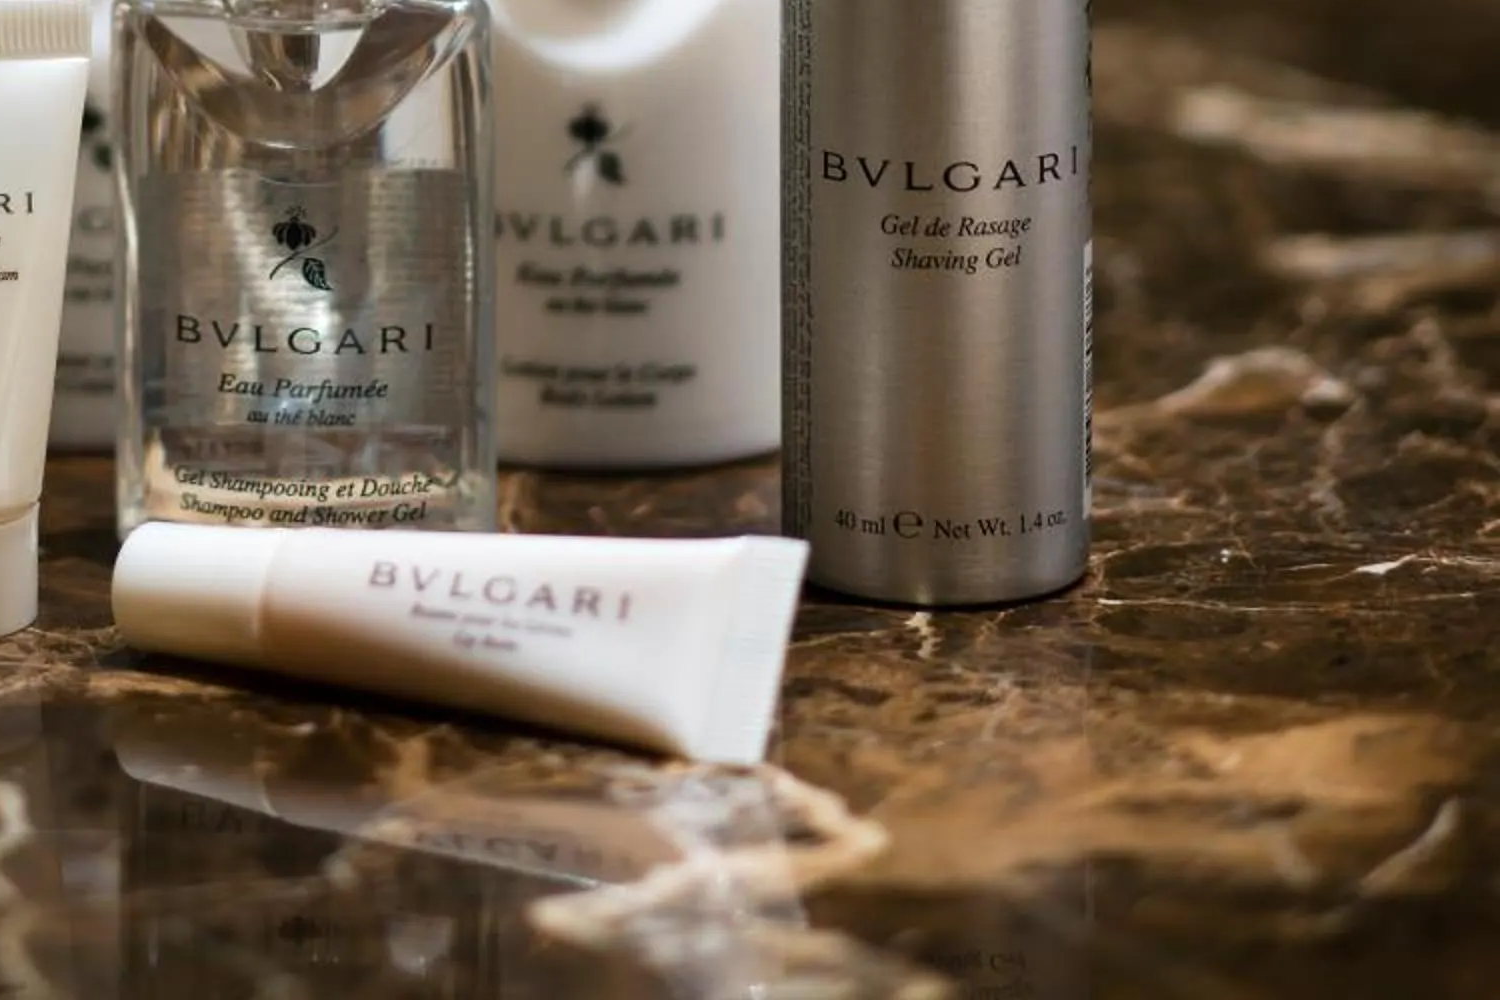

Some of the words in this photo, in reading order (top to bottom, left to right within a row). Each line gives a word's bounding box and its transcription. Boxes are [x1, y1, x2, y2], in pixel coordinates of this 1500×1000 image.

[822, 146, 1079, 193] BVLGARI
[880, 214, 919, 236] Gel
[925, 216, 951, 238] de
[957, 215, 1032, 242] Rasage
[891, 246, 978, 274] Shaving
[985, 245, 1021, 268] Gel
[176, 314, 434, 354] BVLGARI
[218, 373, 265, 395] Eau
[273, 377, 389, 402] Parfumée
[247, 411, 269, 424] au
[275, 408, 301, 426] thé
[306, 408, 356, 427] blanc
[174, 465, 206, 486] Gel
[209, 470, 330, 501] Shampooing
[336, 480, 355, 497] et
[180, 493, 264, 522] Shampoo
[269, 504, 308, 523] and
[312, 505, 387, 527] Shower
[392, 501, 428, 523] Gel
[833, 508, 857, 531] 40
[861, 515, 885, 536] ml
[933, 518, 973, 541] Net
[977, 518, 1011, 537] Wt.
[1020, 512, 1044, 533] 1.4
[368, 560, 633, 621] BVLGARI
